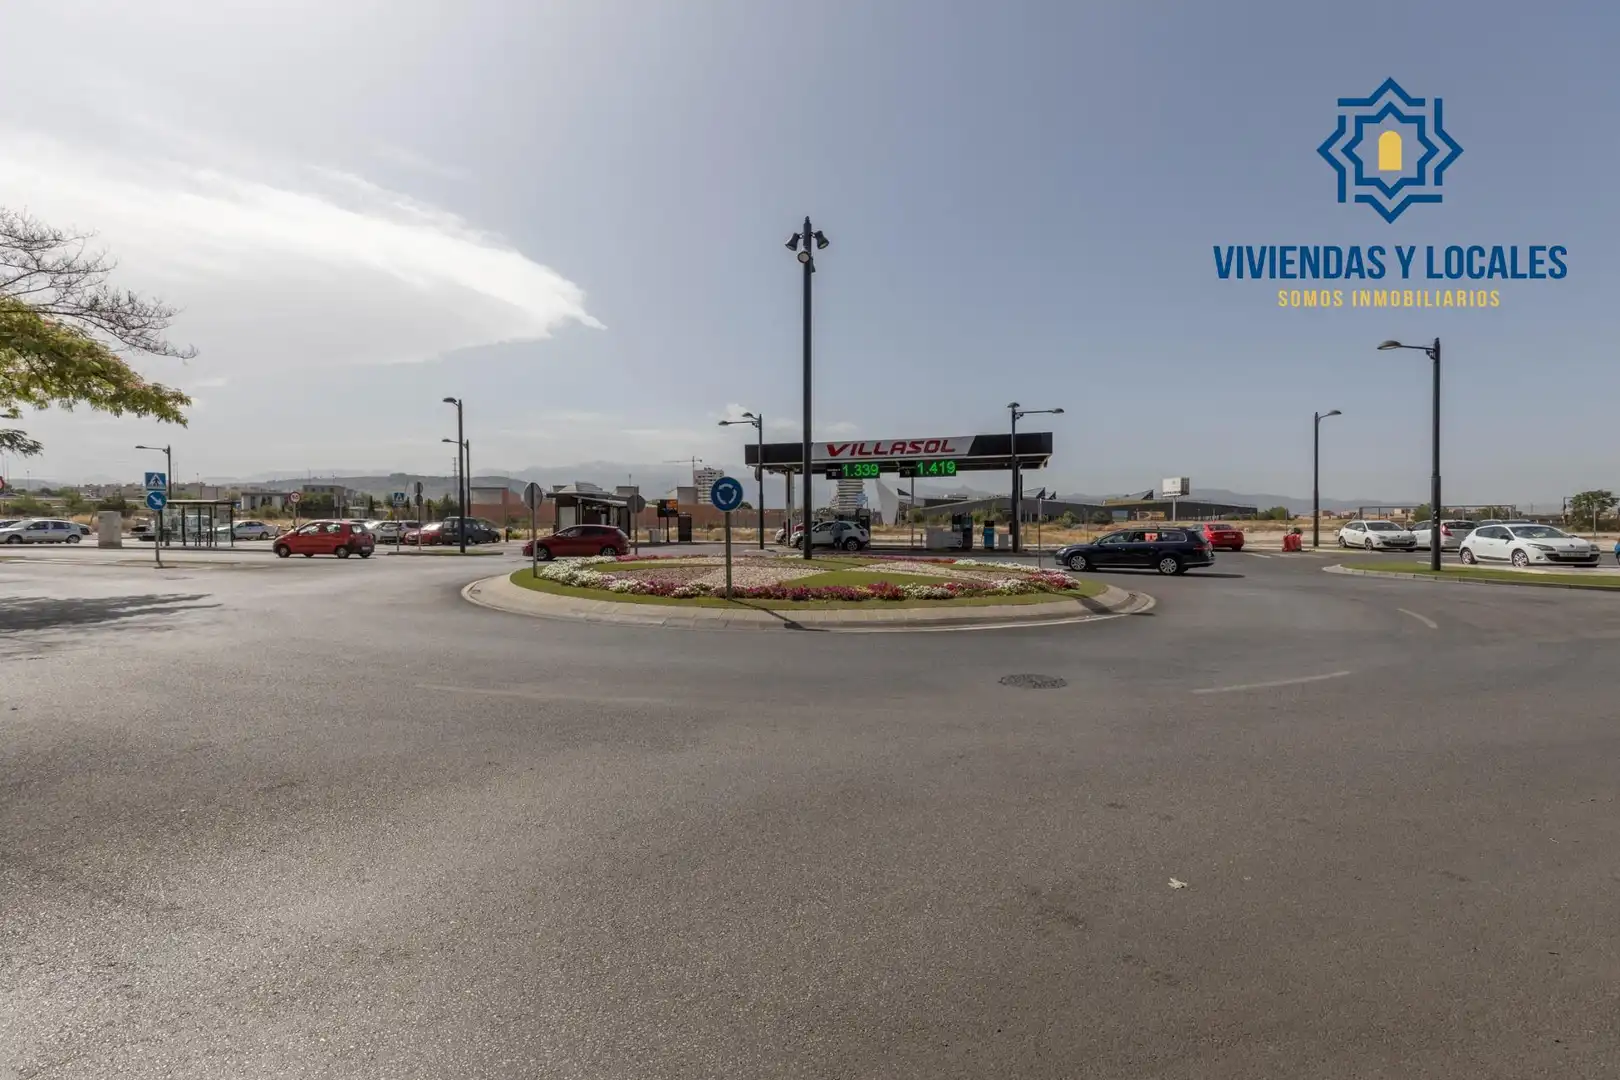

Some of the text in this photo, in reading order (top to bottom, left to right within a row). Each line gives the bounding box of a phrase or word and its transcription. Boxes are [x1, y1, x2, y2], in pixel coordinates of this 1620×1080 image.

[826, 439, 956, 457] VILLASOL
[842, 463, 879, 477] 1.339
[916, 460, 956, 475] 1.419
